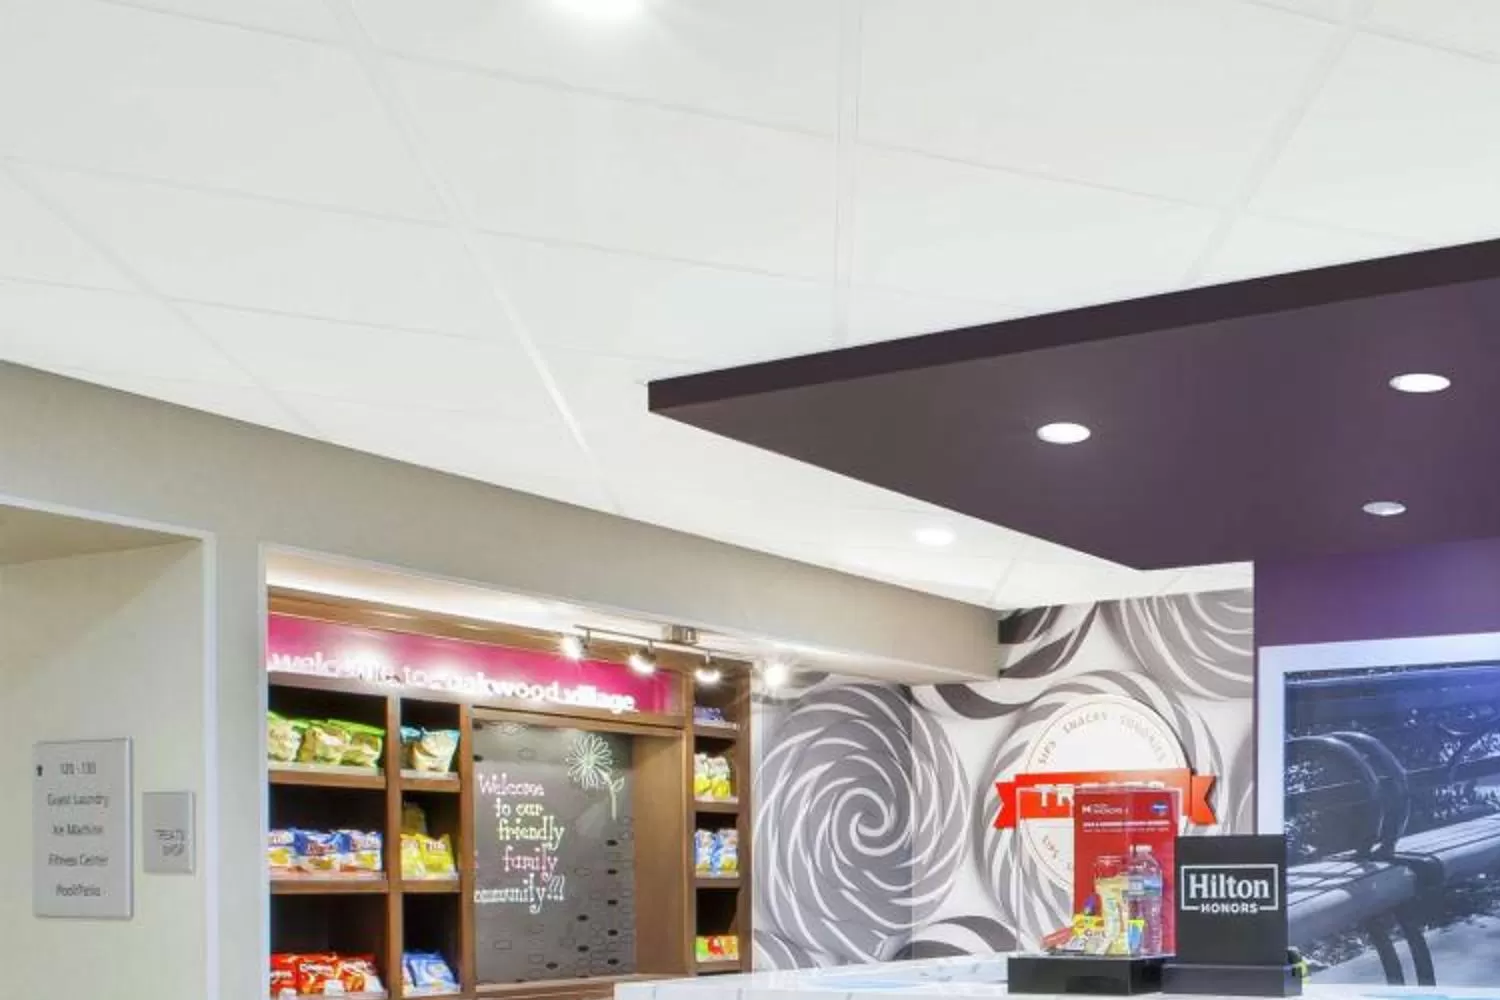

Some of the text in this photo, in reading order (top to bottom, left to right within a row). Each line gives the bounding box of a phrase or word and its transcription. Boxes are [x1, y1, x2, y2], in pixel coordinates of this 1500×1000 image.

[403, 665, 428, 686] to
[478, 772, 545, 796] Welcome
[494, 797, 512, 818] to
[497, 815, 565, 851] friendly
[501, 844, 558, 884] family
[1189, 872, 1270, 899] Hilton
[1201, 903, 1258, 914] HONORS
